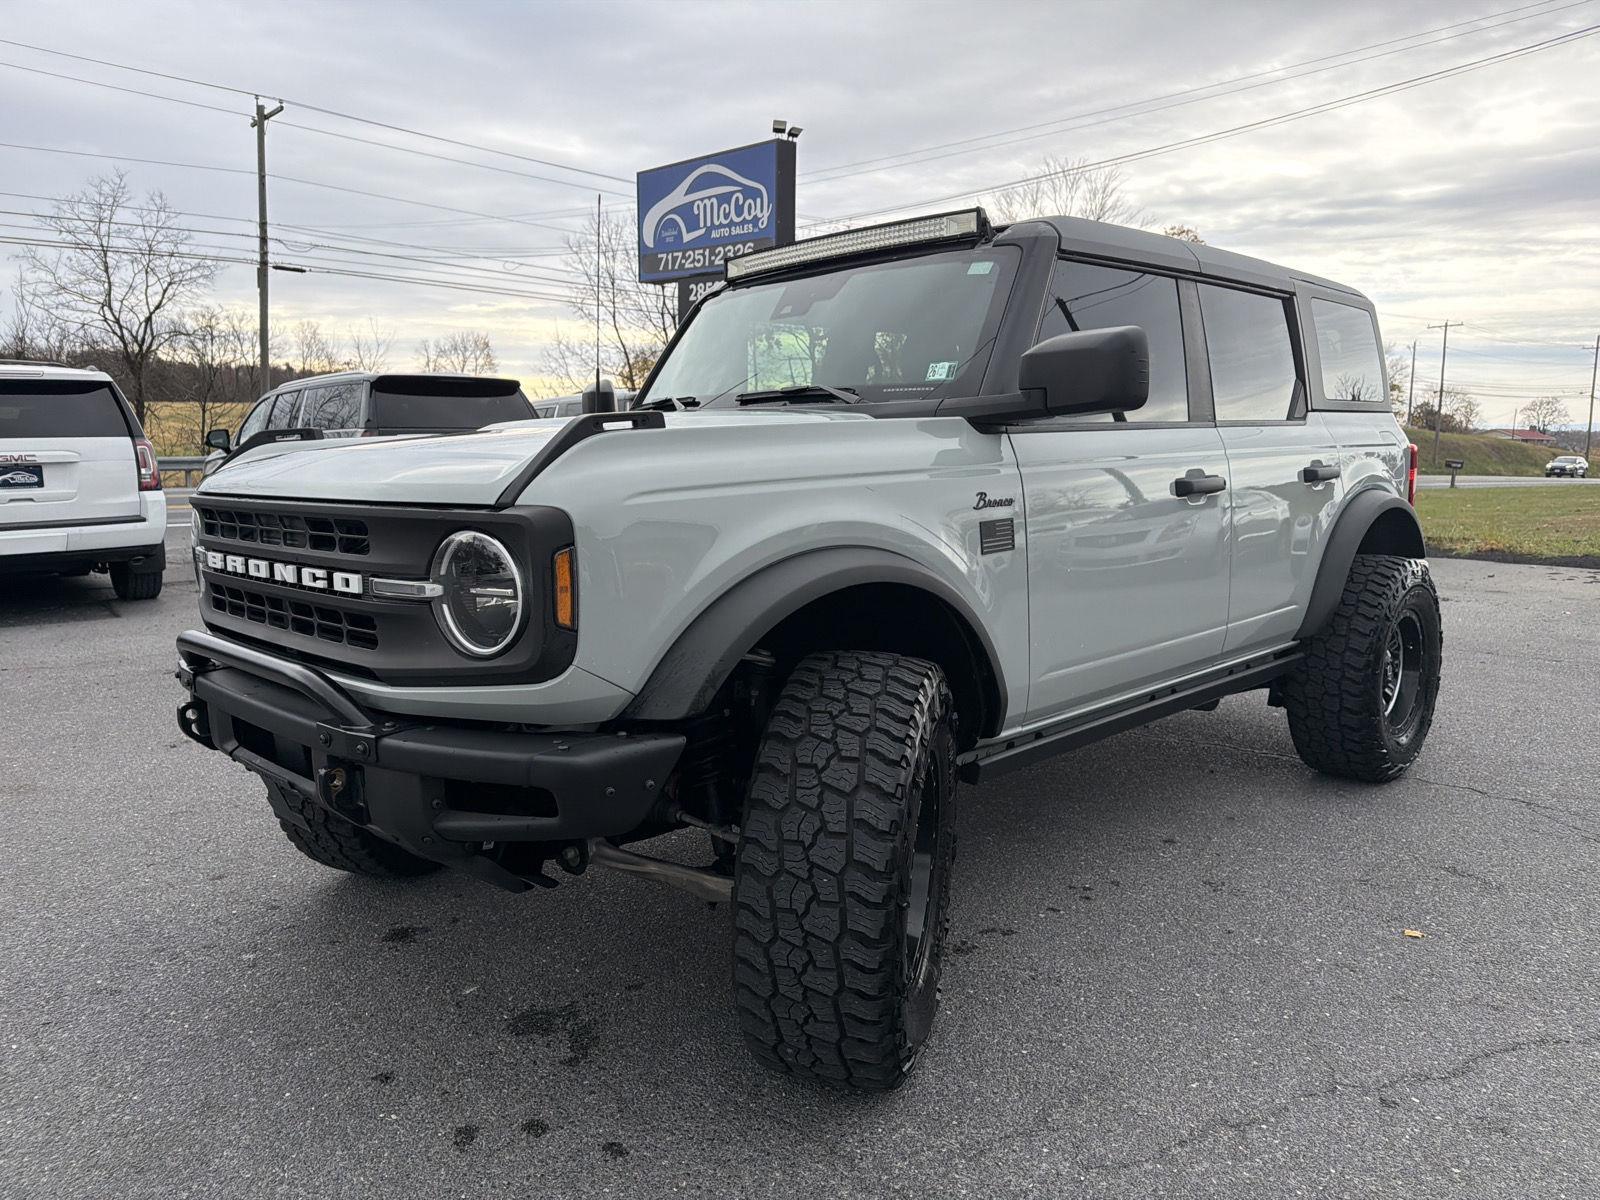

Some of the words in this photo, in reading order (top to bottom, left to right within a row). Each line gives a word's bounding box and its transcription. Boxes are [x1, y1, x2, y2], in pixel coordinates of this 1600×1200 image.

[693, 192, 772, 229] McCoy
[711, 228, 730, 239] AUTO
[731, 223, 753, 236] SALES
[0, 454, 37, 463] GMC
[973, 491, 1015, 511] Bronco
[207, 551, 363, 594] BRONCO
